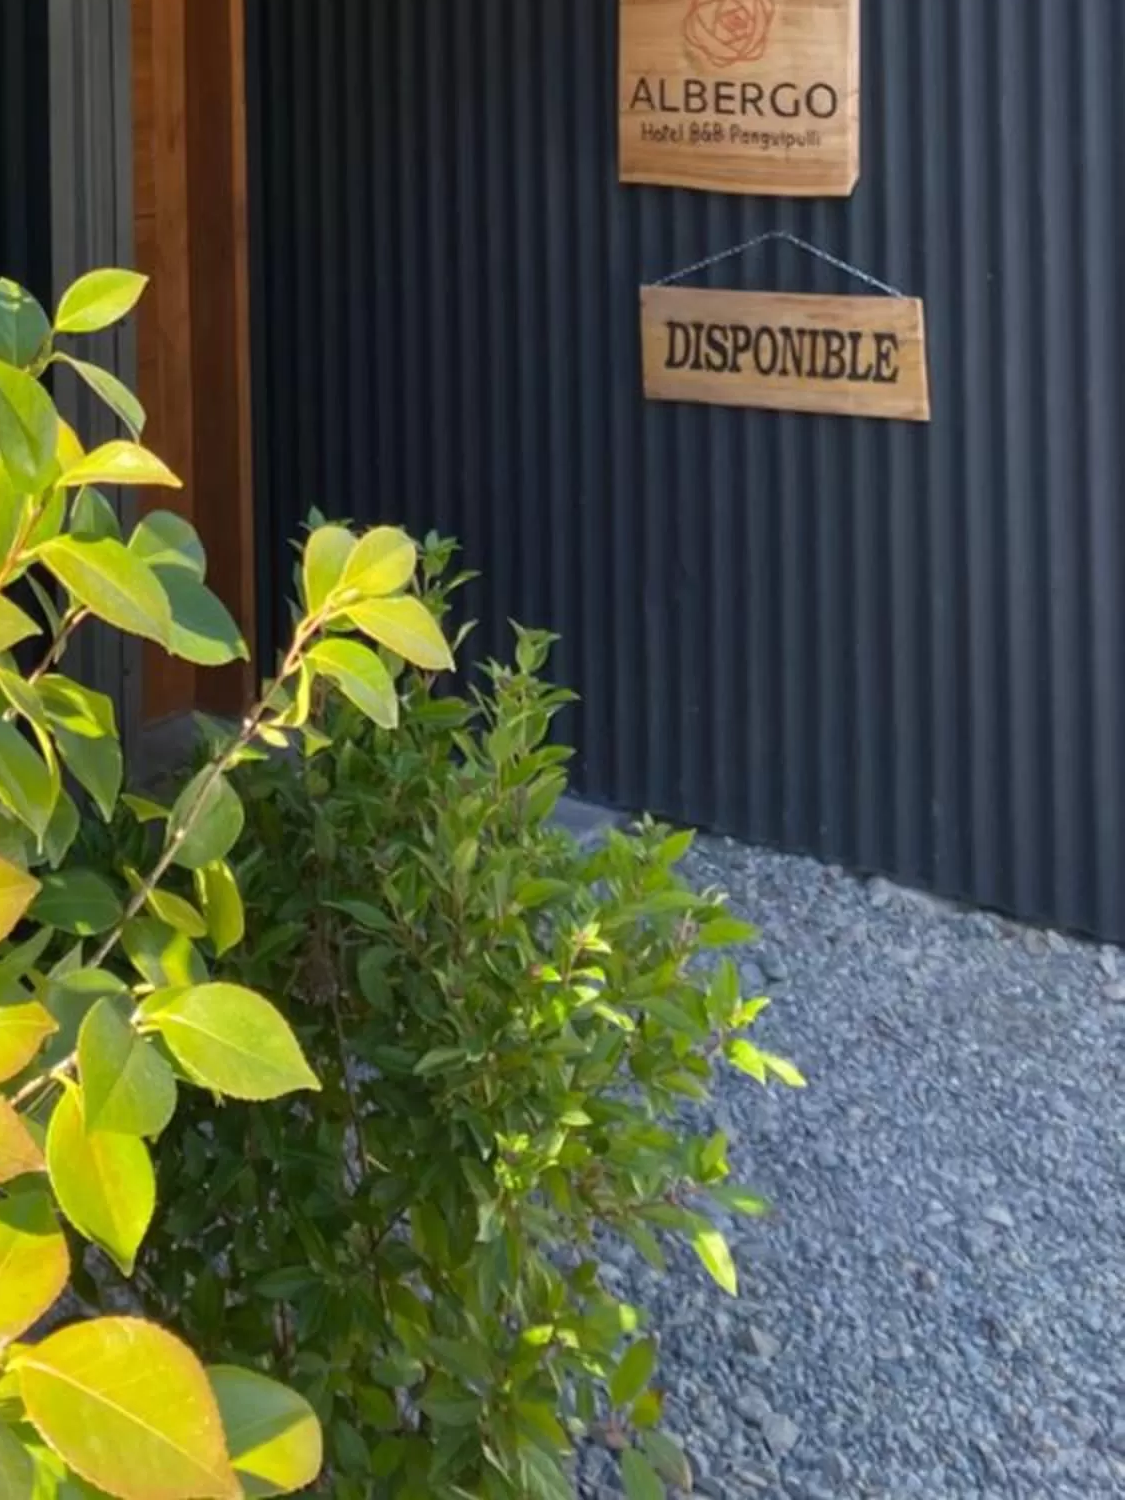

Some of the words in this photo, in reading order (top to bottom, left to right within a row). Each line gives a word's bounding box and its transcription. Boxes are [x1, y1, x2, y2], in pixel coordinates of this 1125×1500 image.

[629, 76, 838, 119] ALBERGO
[640, 122, 684, 143] Hotel
[689, 121, 725, 146] B&B
[729, 123, 822, 150] Panguipulli
[664, 320, 901, 384] DISPONIBLE
